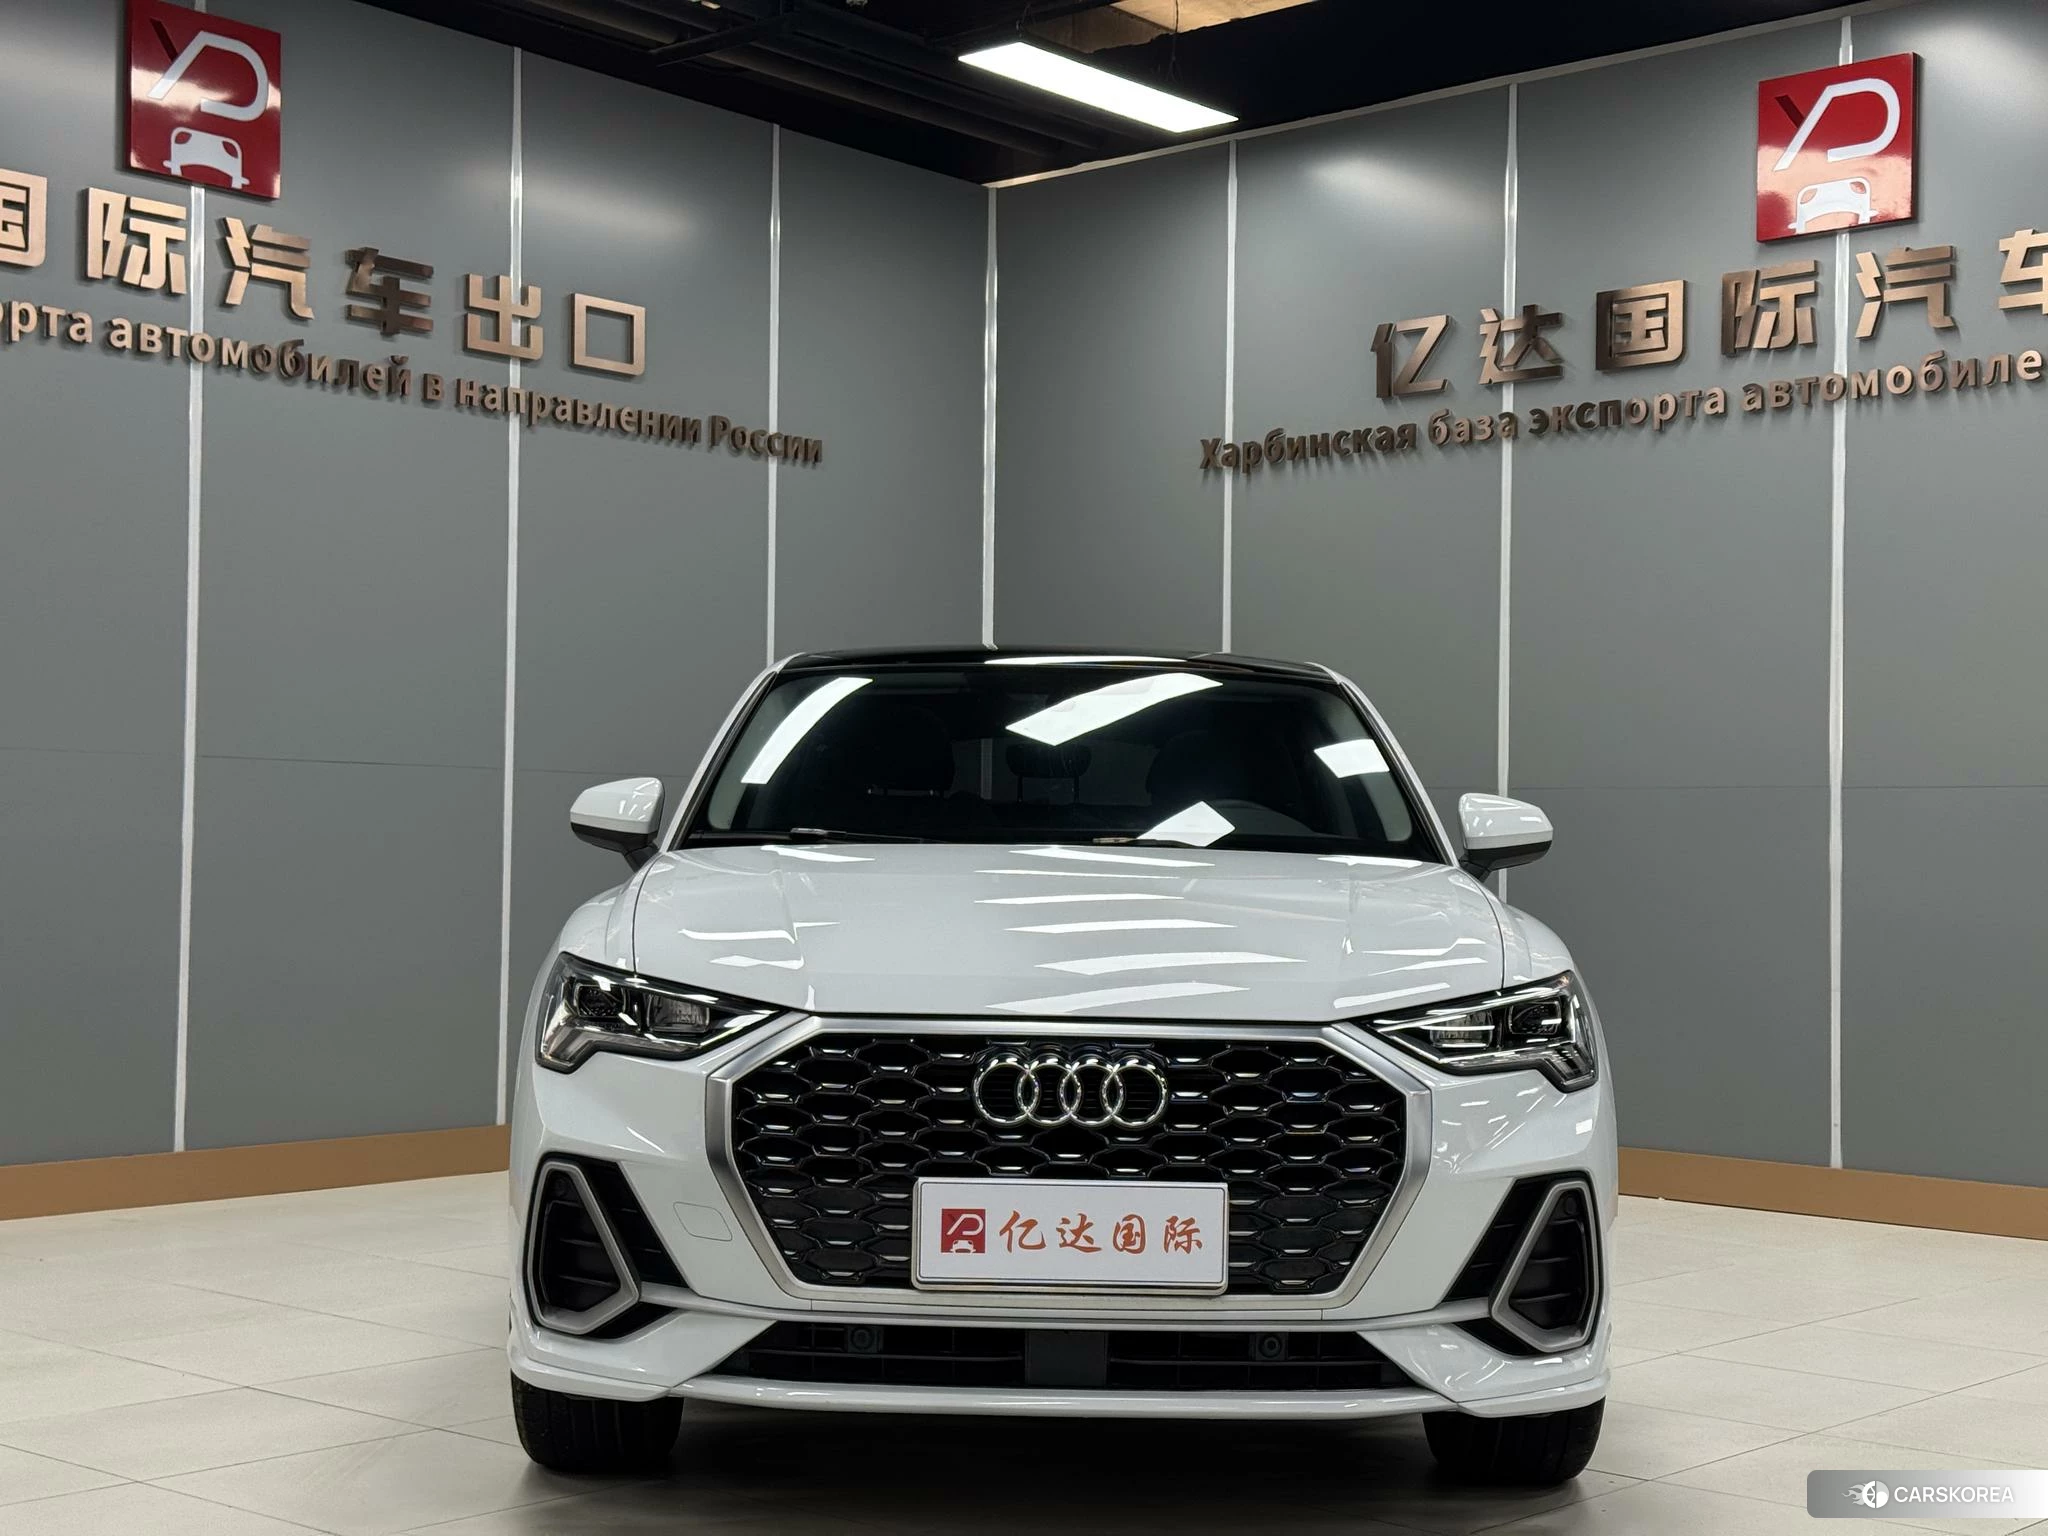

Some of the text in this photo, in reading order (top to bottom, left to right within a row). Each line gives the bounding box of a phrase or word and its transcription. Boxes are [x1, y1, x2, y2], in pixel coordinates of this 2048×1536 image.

[0, 300, 822, 463] рта автомобилей в направлении России
[1200, 421, 1418, 473] Харбинская
[1428, 408, 1519, 447] база
[1528, 385, 1727, 434] экспорта
[999, 1210, 1203, 1255] 亿达国际
